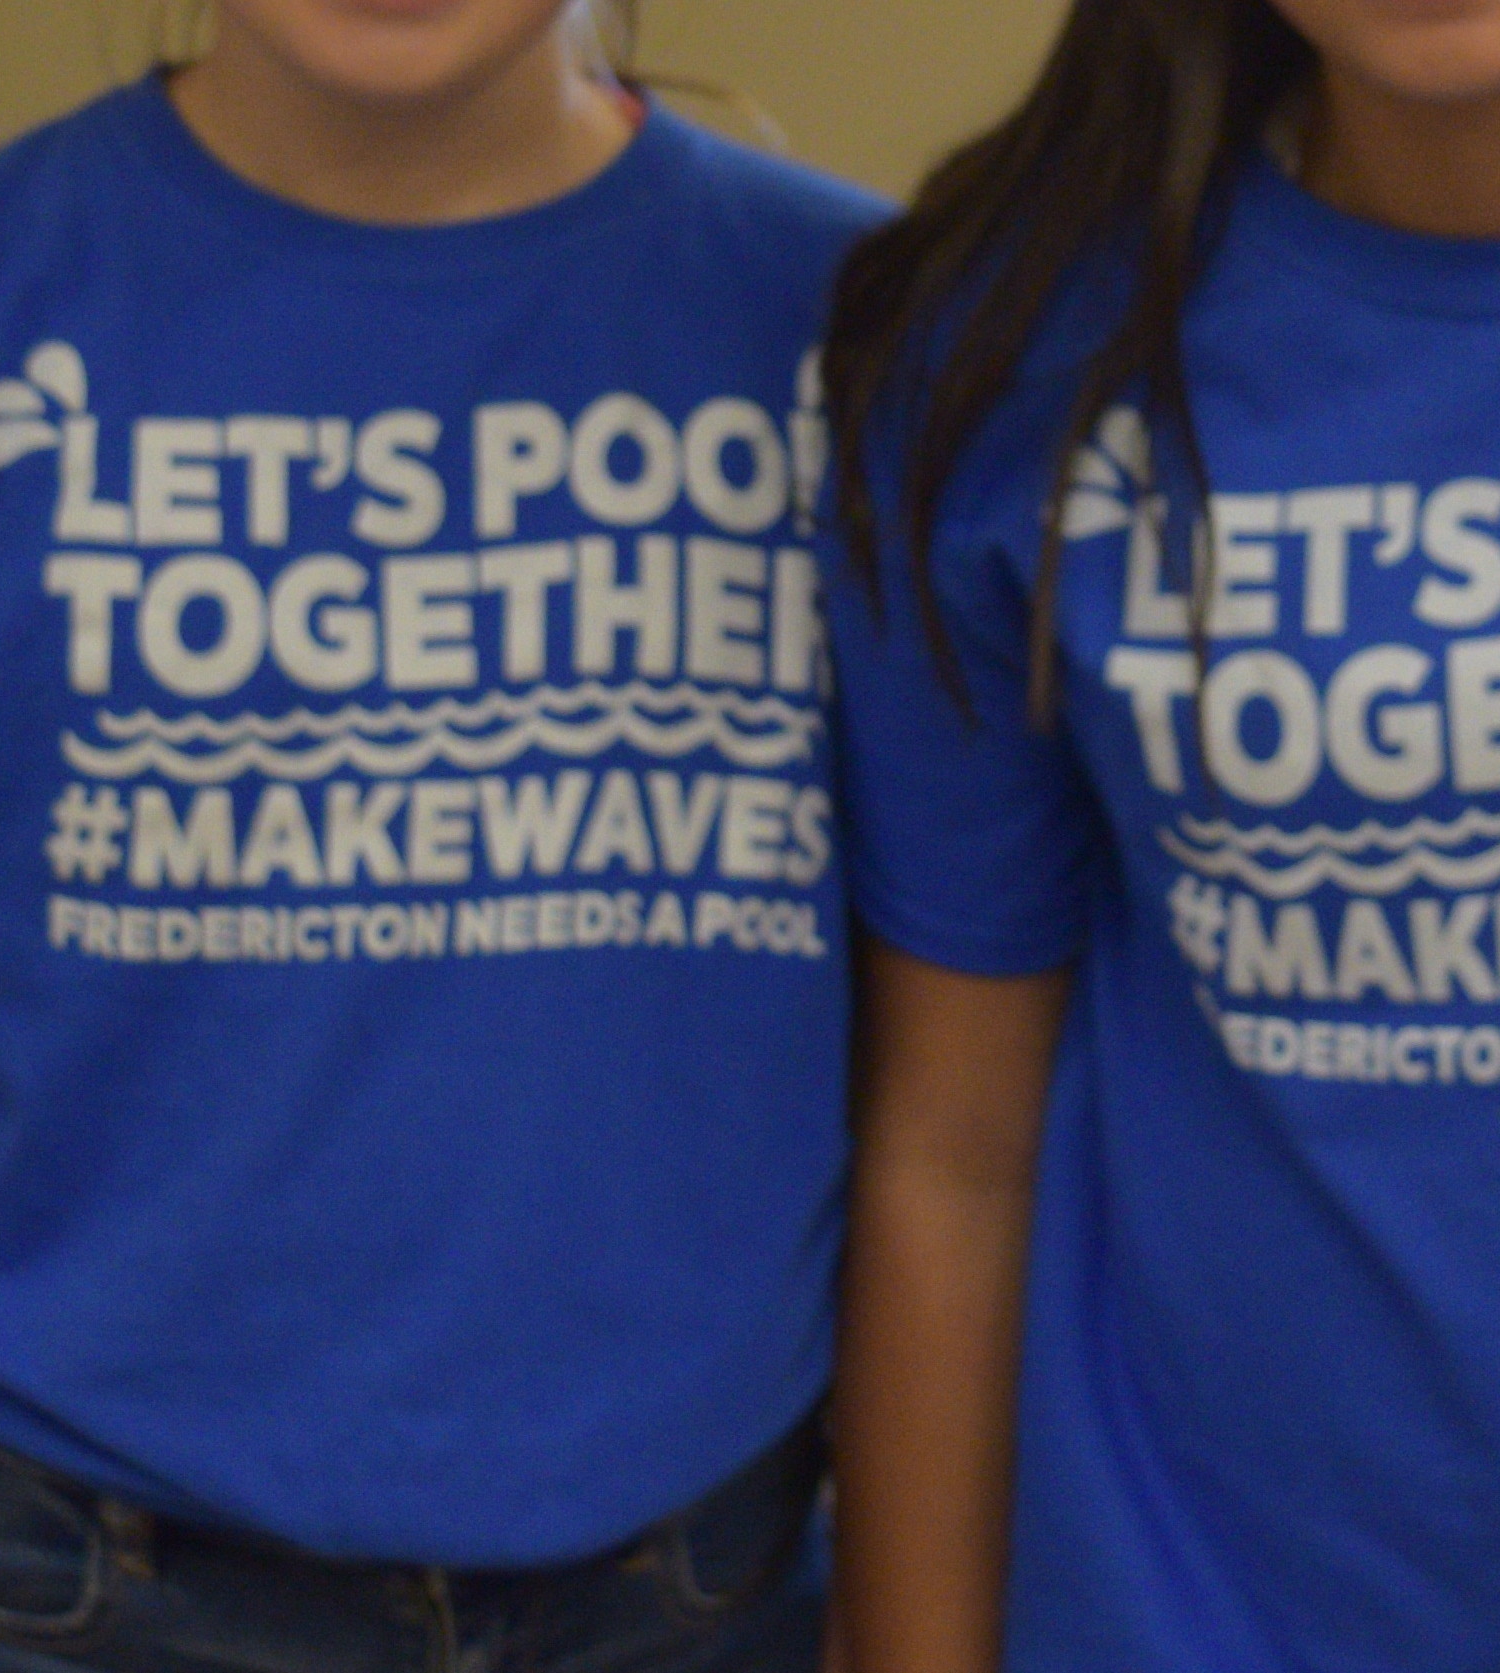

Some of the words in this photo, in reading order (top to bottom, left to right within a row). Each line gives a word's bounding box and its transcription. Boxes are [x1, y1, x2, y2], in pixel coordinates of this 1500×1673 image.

[54, 409, 445, 548] LET’S
[46, 771, 832, 890] #MAKEWAVES
[48, 894, 448, 962] FREDERICTON
[455, 888, 644, 957] NEEDS
[645, 890, 687, 949] A
[693, 890, 828, 959] POOL
